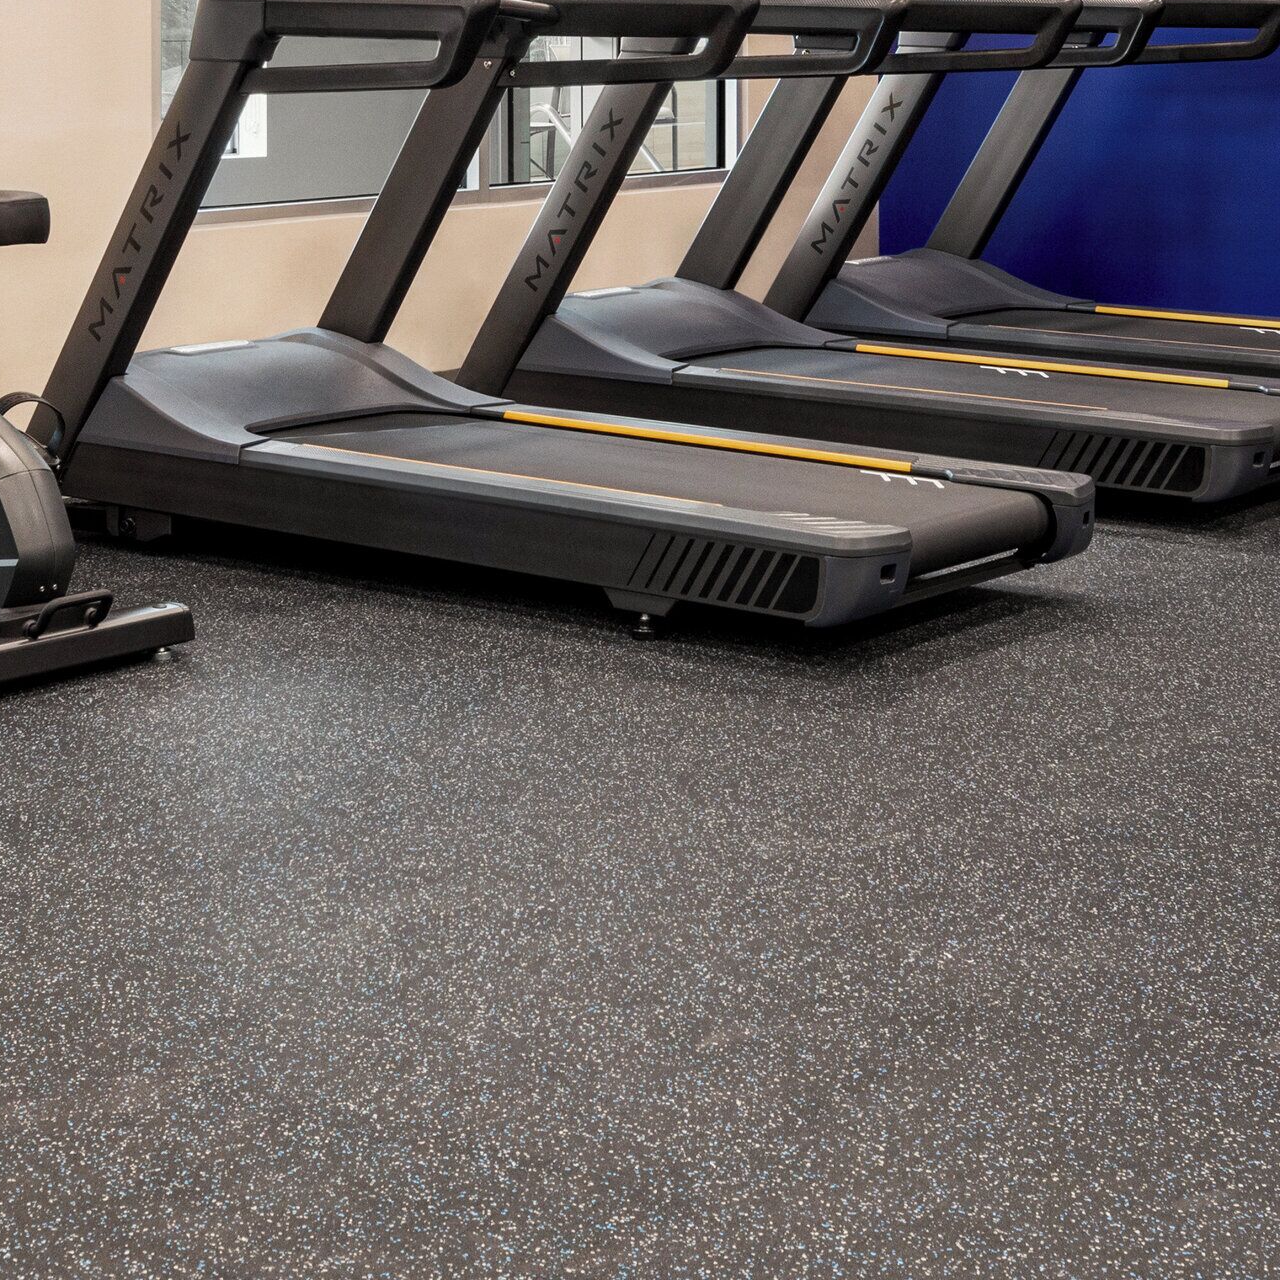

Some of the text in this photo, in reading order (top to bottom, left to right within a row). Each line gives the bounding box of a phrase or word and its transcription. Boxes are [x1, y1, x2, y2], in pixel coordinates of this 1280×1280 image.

[87, 121, 192, 342] MATRIX
[524, 107, 625, 292] MATRIX
[810, 91, 904, 255] MATRIX
